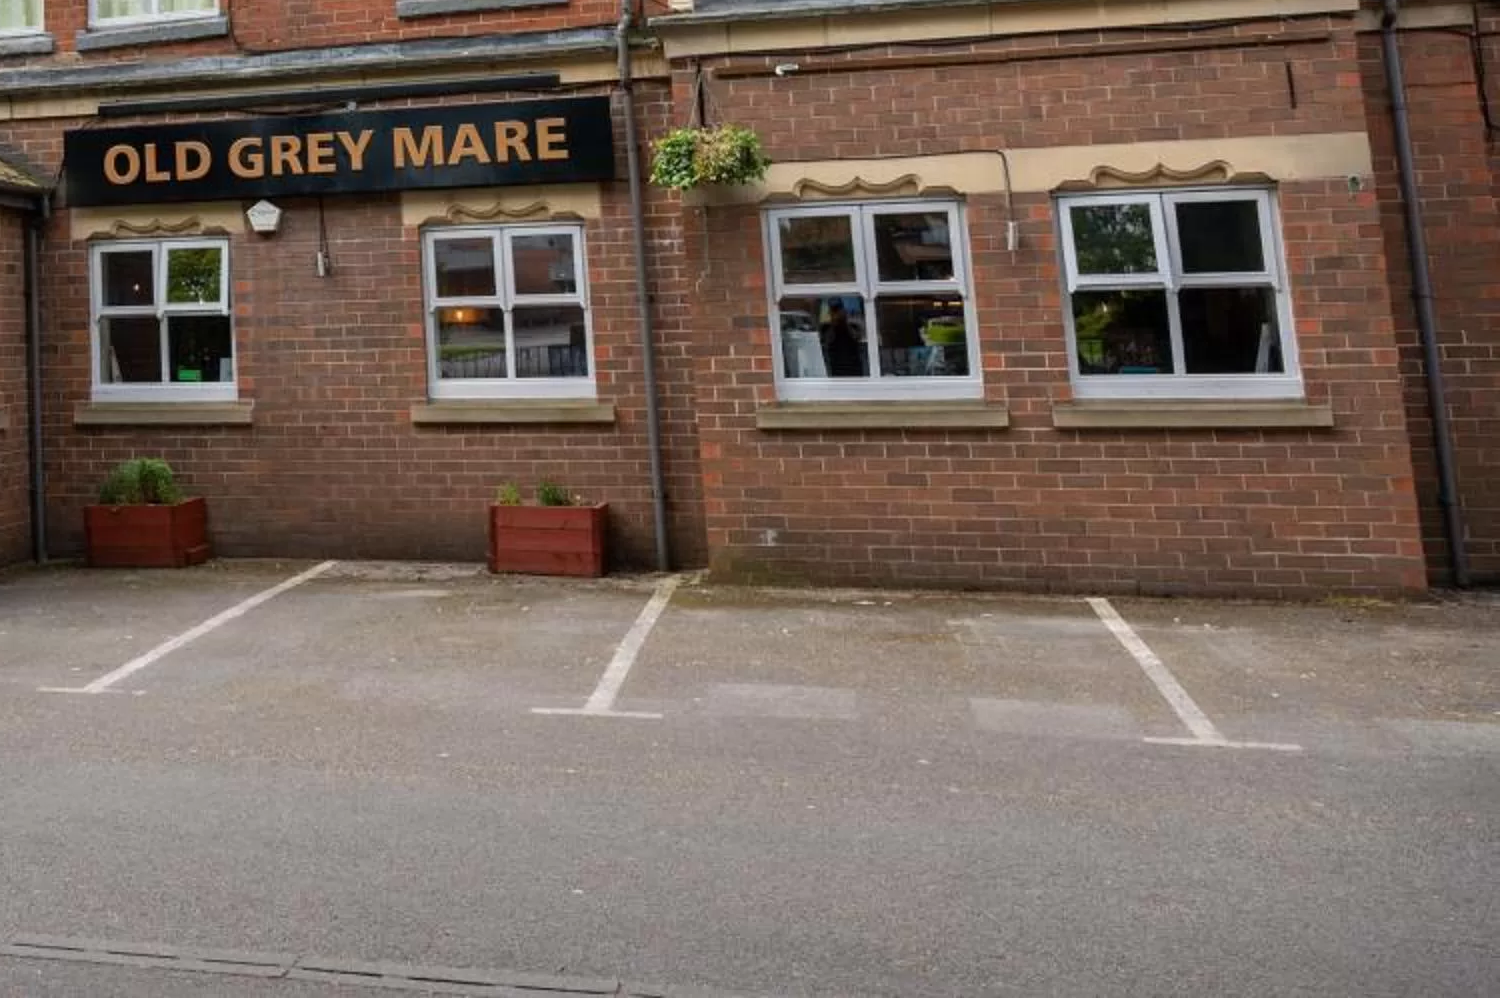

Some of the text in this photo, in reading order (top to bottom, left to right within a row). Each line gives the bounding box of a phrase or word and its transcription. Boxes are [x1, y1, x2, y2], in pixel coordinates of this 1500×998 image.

[103, 117, 570, 185] OLD GREY MARE
